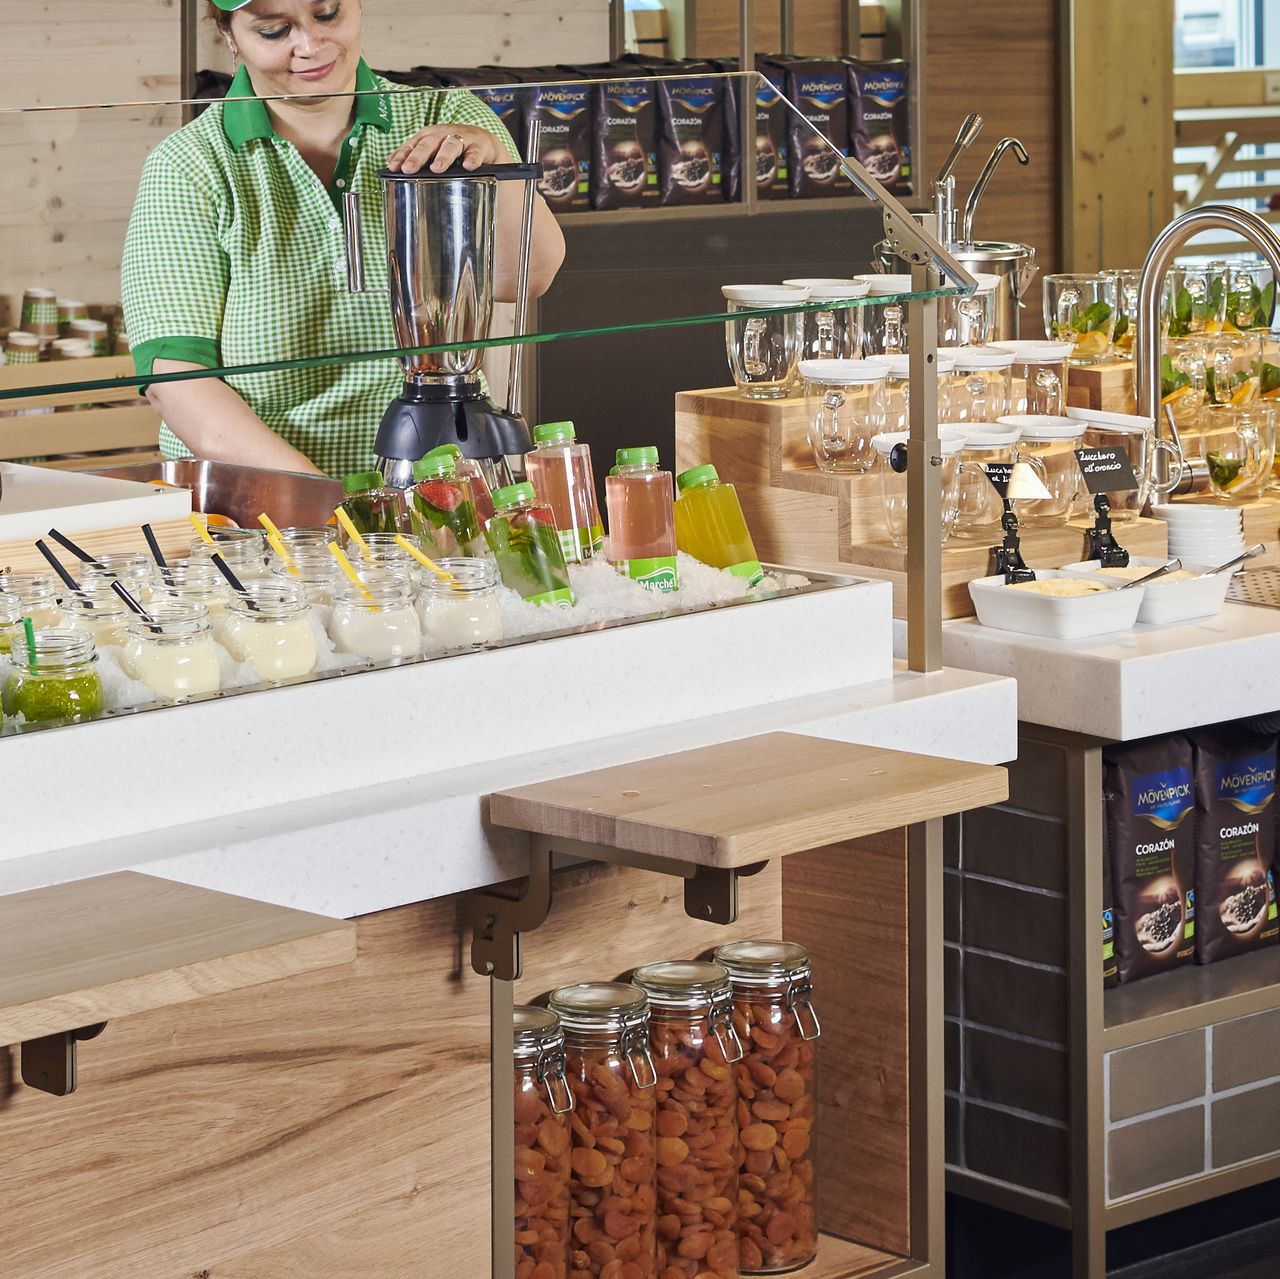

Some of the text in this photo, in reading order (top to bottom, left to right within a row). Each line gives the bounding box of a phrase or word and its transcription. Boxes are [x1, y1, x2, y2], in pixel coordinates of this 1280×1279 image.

[607, 117, 637, 126] CORAZÓN
[806, 113, 830, 122] ORAZÓN
[640, 577, 674, 590] Marché
[1220, 768, 1276, 791] MÖVENPICK
[1138, 783, 1191, 807] MÖVENPICK
[1219, 822, 1260, 839] CORAZÓN
[1135, 838, 1175, 856] CORAZÓN
